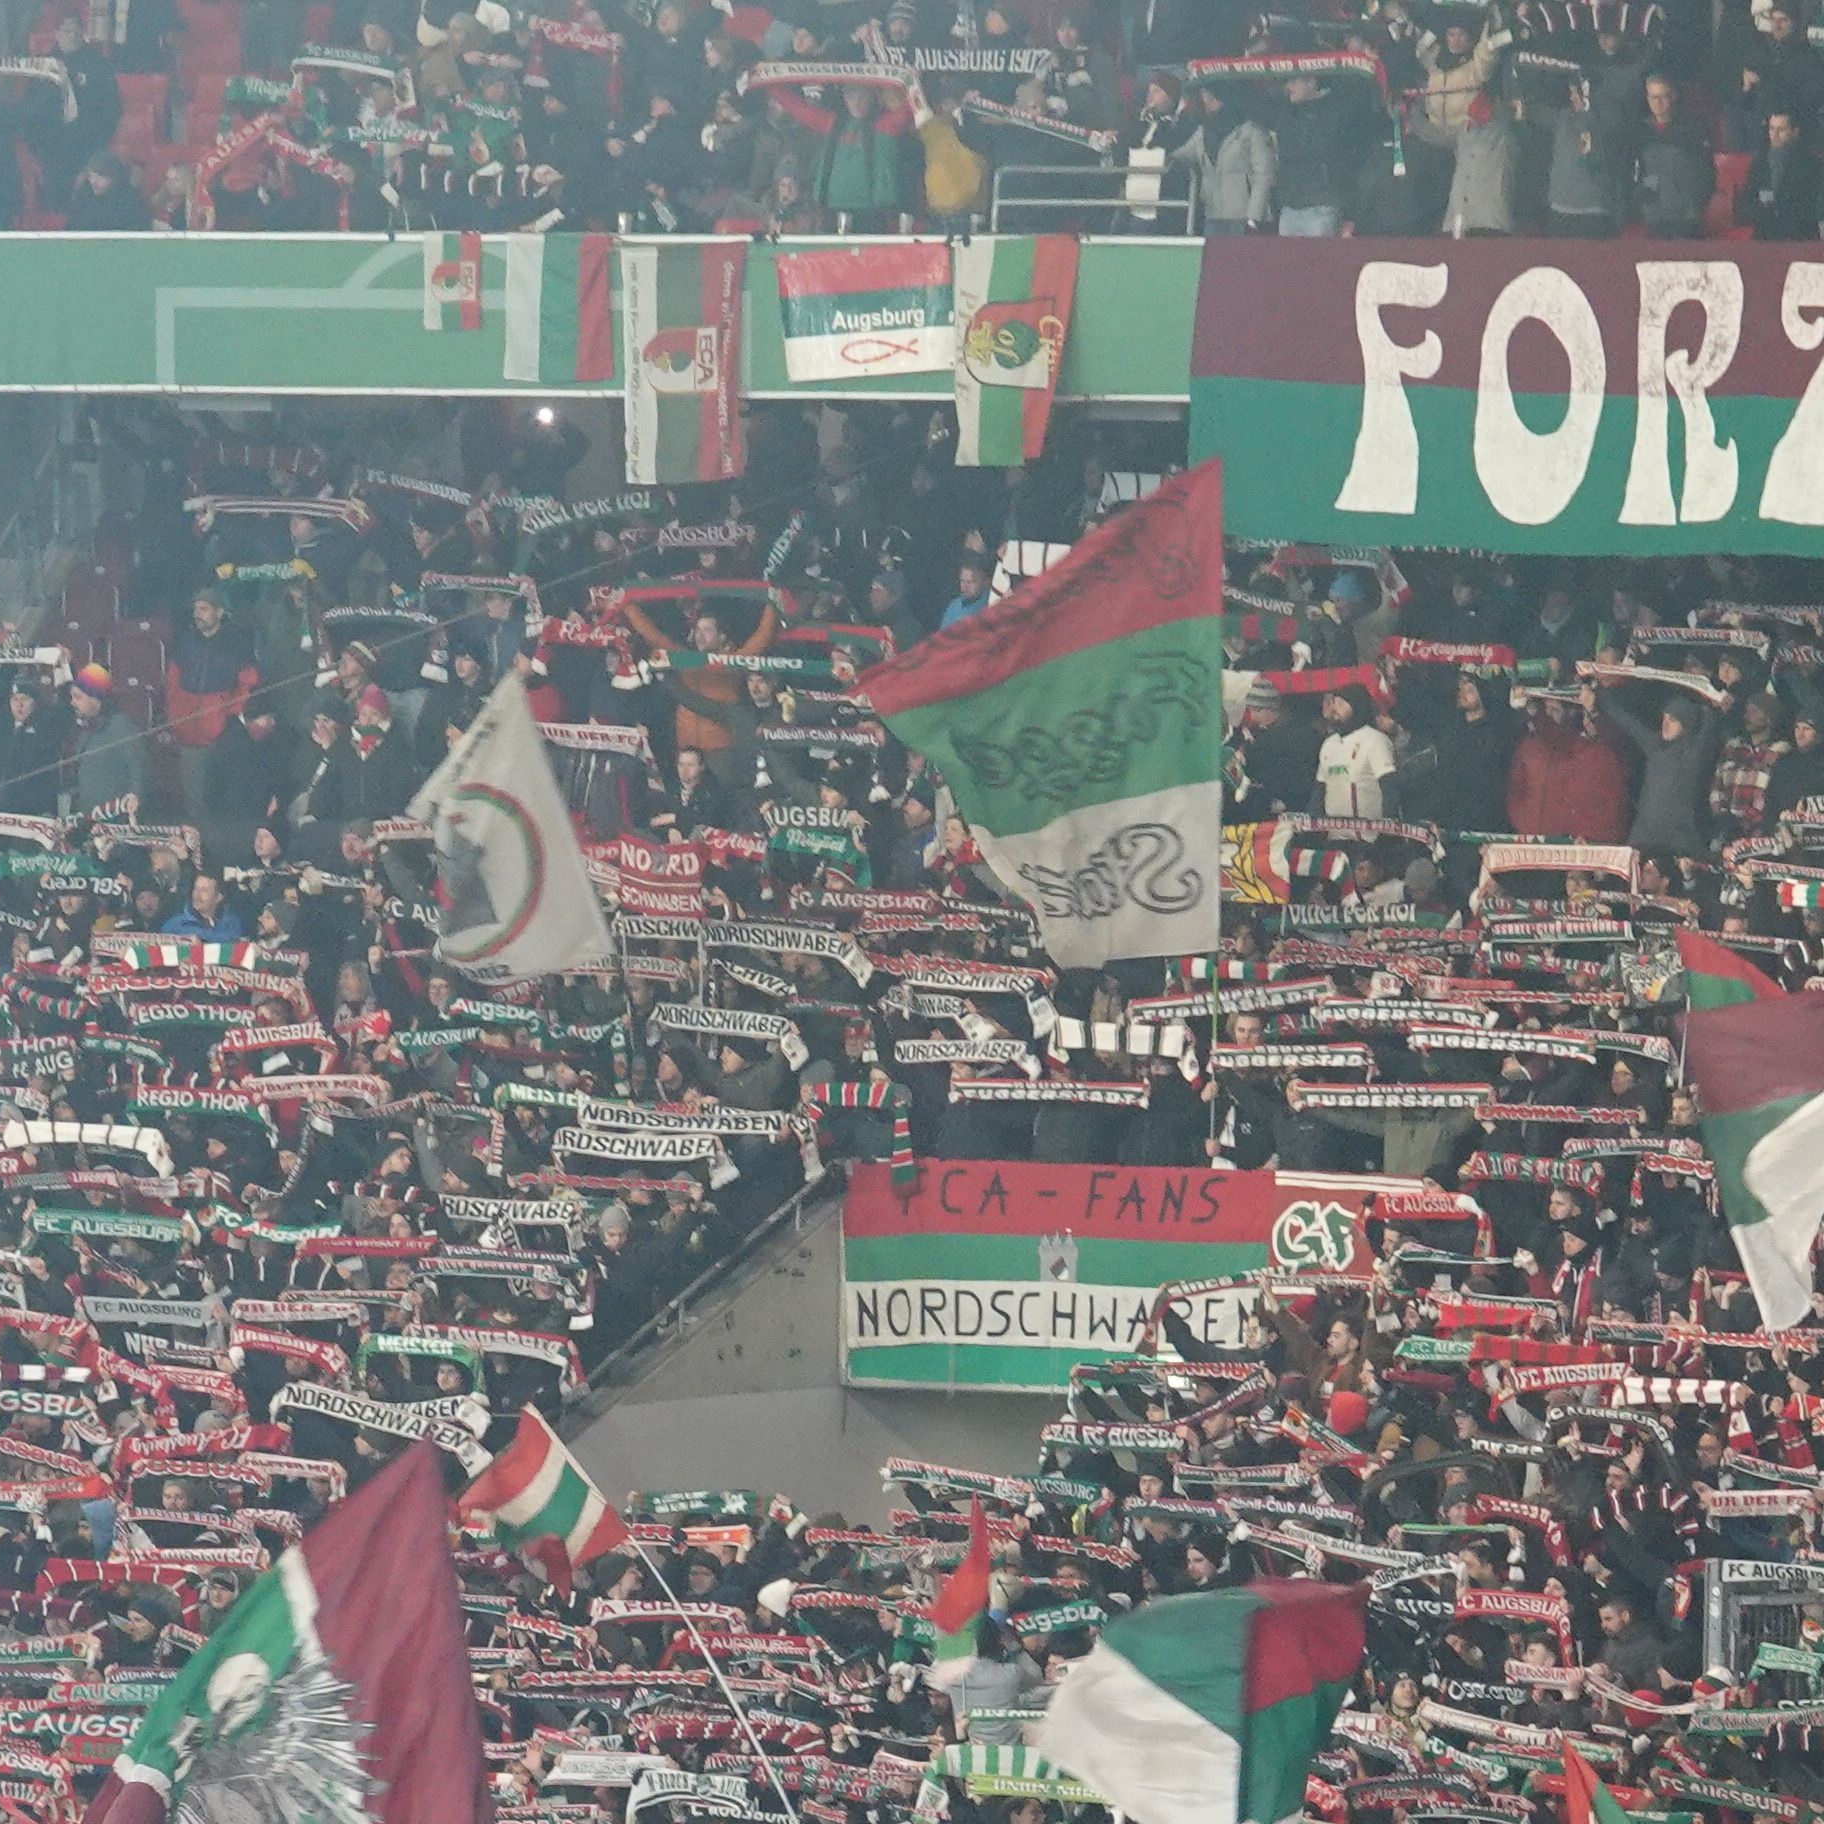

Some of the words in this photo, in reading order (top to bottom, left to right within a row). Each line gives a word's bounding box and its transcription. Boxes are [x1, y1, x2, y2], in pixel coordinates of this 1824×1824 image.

[913, 45, 1004, 73] AUGSBURG
[832, 307, 925, 329] Augsburg
[695, 329, 713, 387] FCA
[192, 1005, 255, 1026] THOR
[1319, 1005, 1485, 1027] FUGGERSTADT
[1415, 1030, 1582, 1058] FUGGERSTADT
[137, 1089, 190, 1109] REGIO
[194, 1091, 248, 1113] THOR
[1305, 1091, 1481, 1108] FUGGERSTADT
[580, 1103, 781, 1135] NORDSCHWABEN
[1086, 1172, 1225, 1224] FANS
[34, 1214, 62, 1233] FC
[1727, 1563, 1752, 1579] FC
[1657, 1776, 1687, 1793] FC
[1691, 1781, 1799, 1817] AUGSBURG
